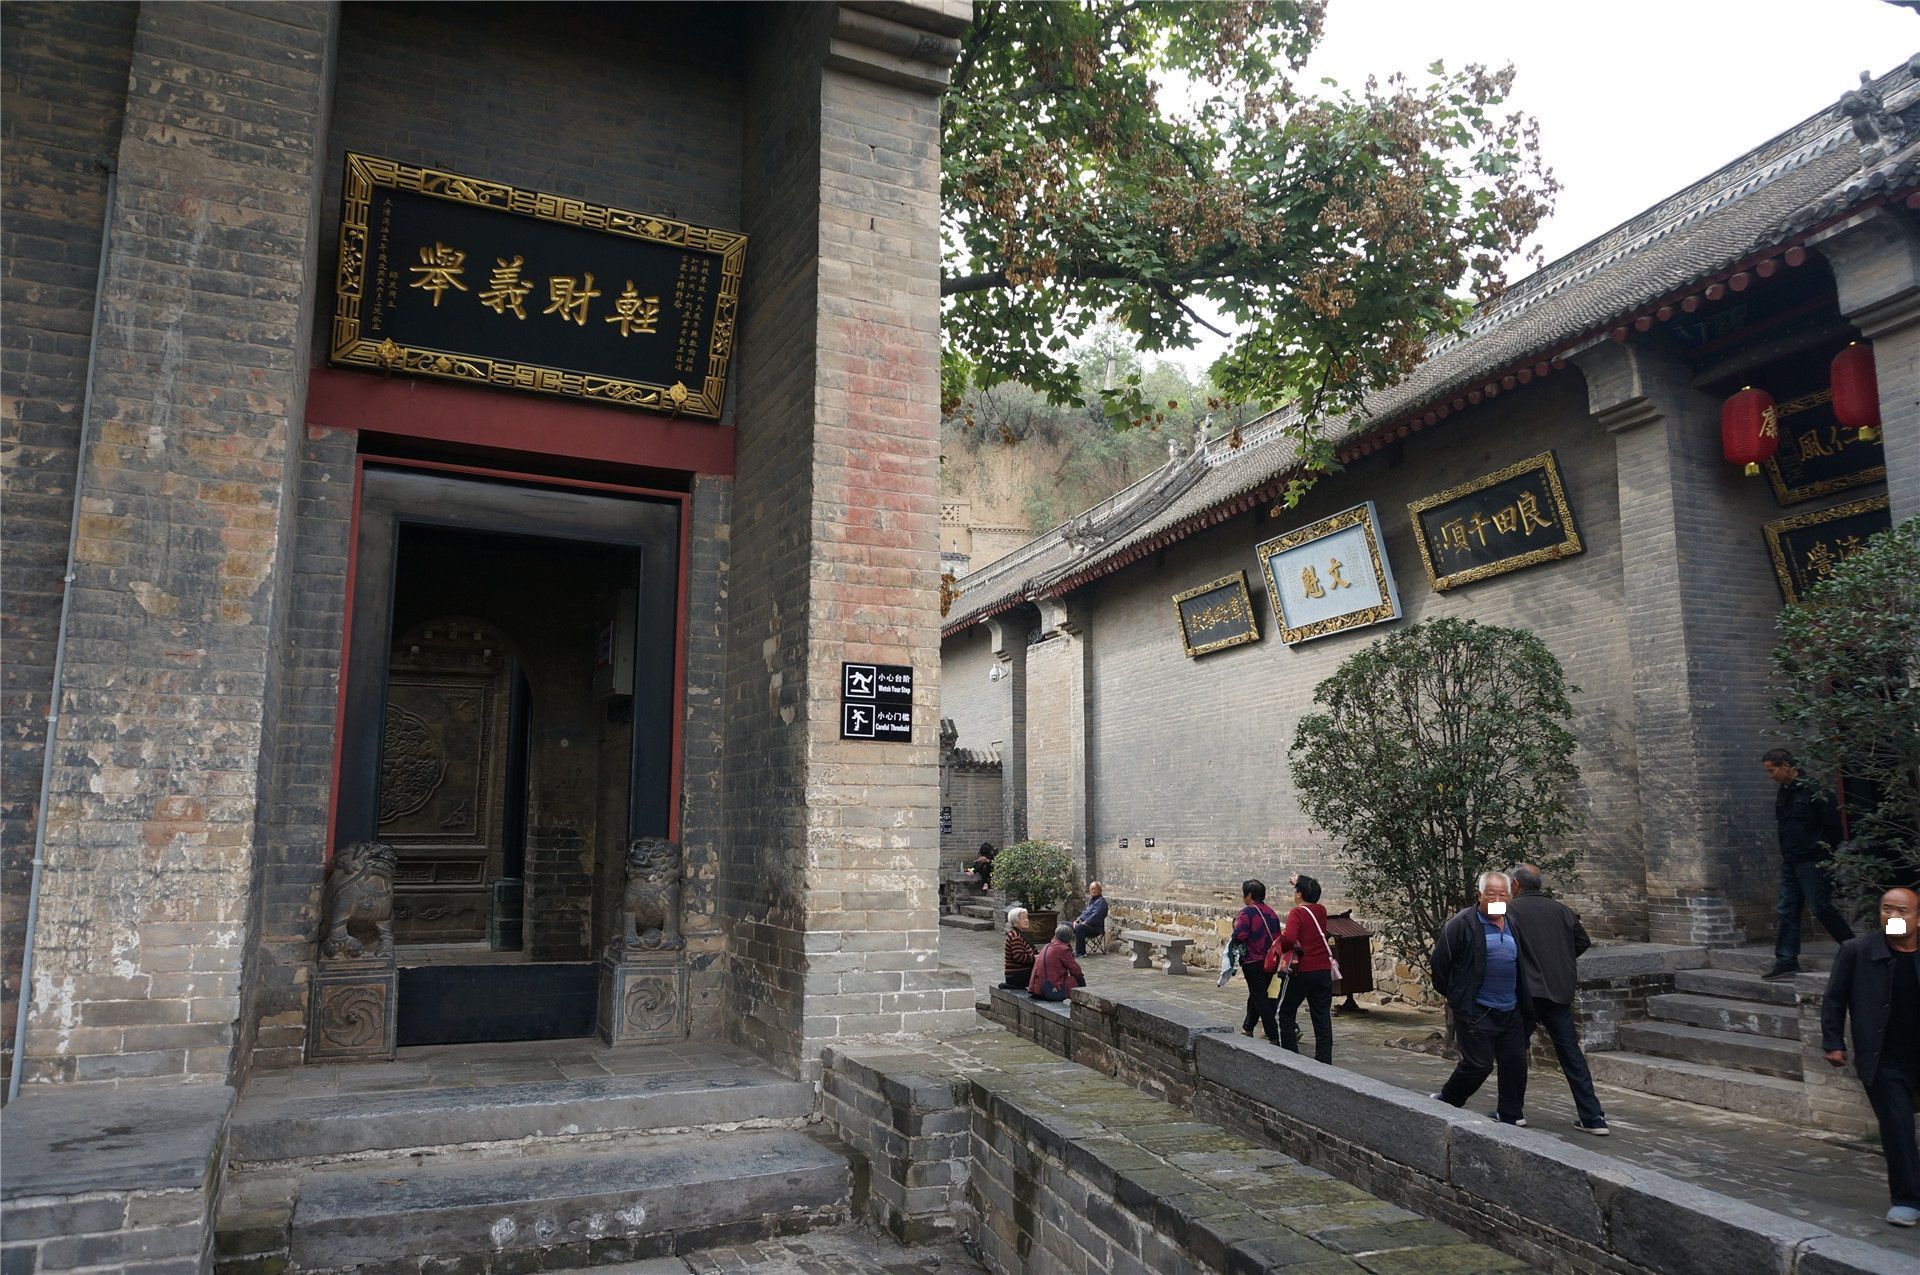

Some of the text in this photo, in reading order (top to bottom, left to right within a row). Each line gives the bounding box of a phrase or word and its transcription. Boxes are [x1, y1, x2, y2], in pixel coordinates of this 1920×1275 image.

[878, 673, 911, 682] 小心台阶
[877, 712, 910, 721] 小心门槛
